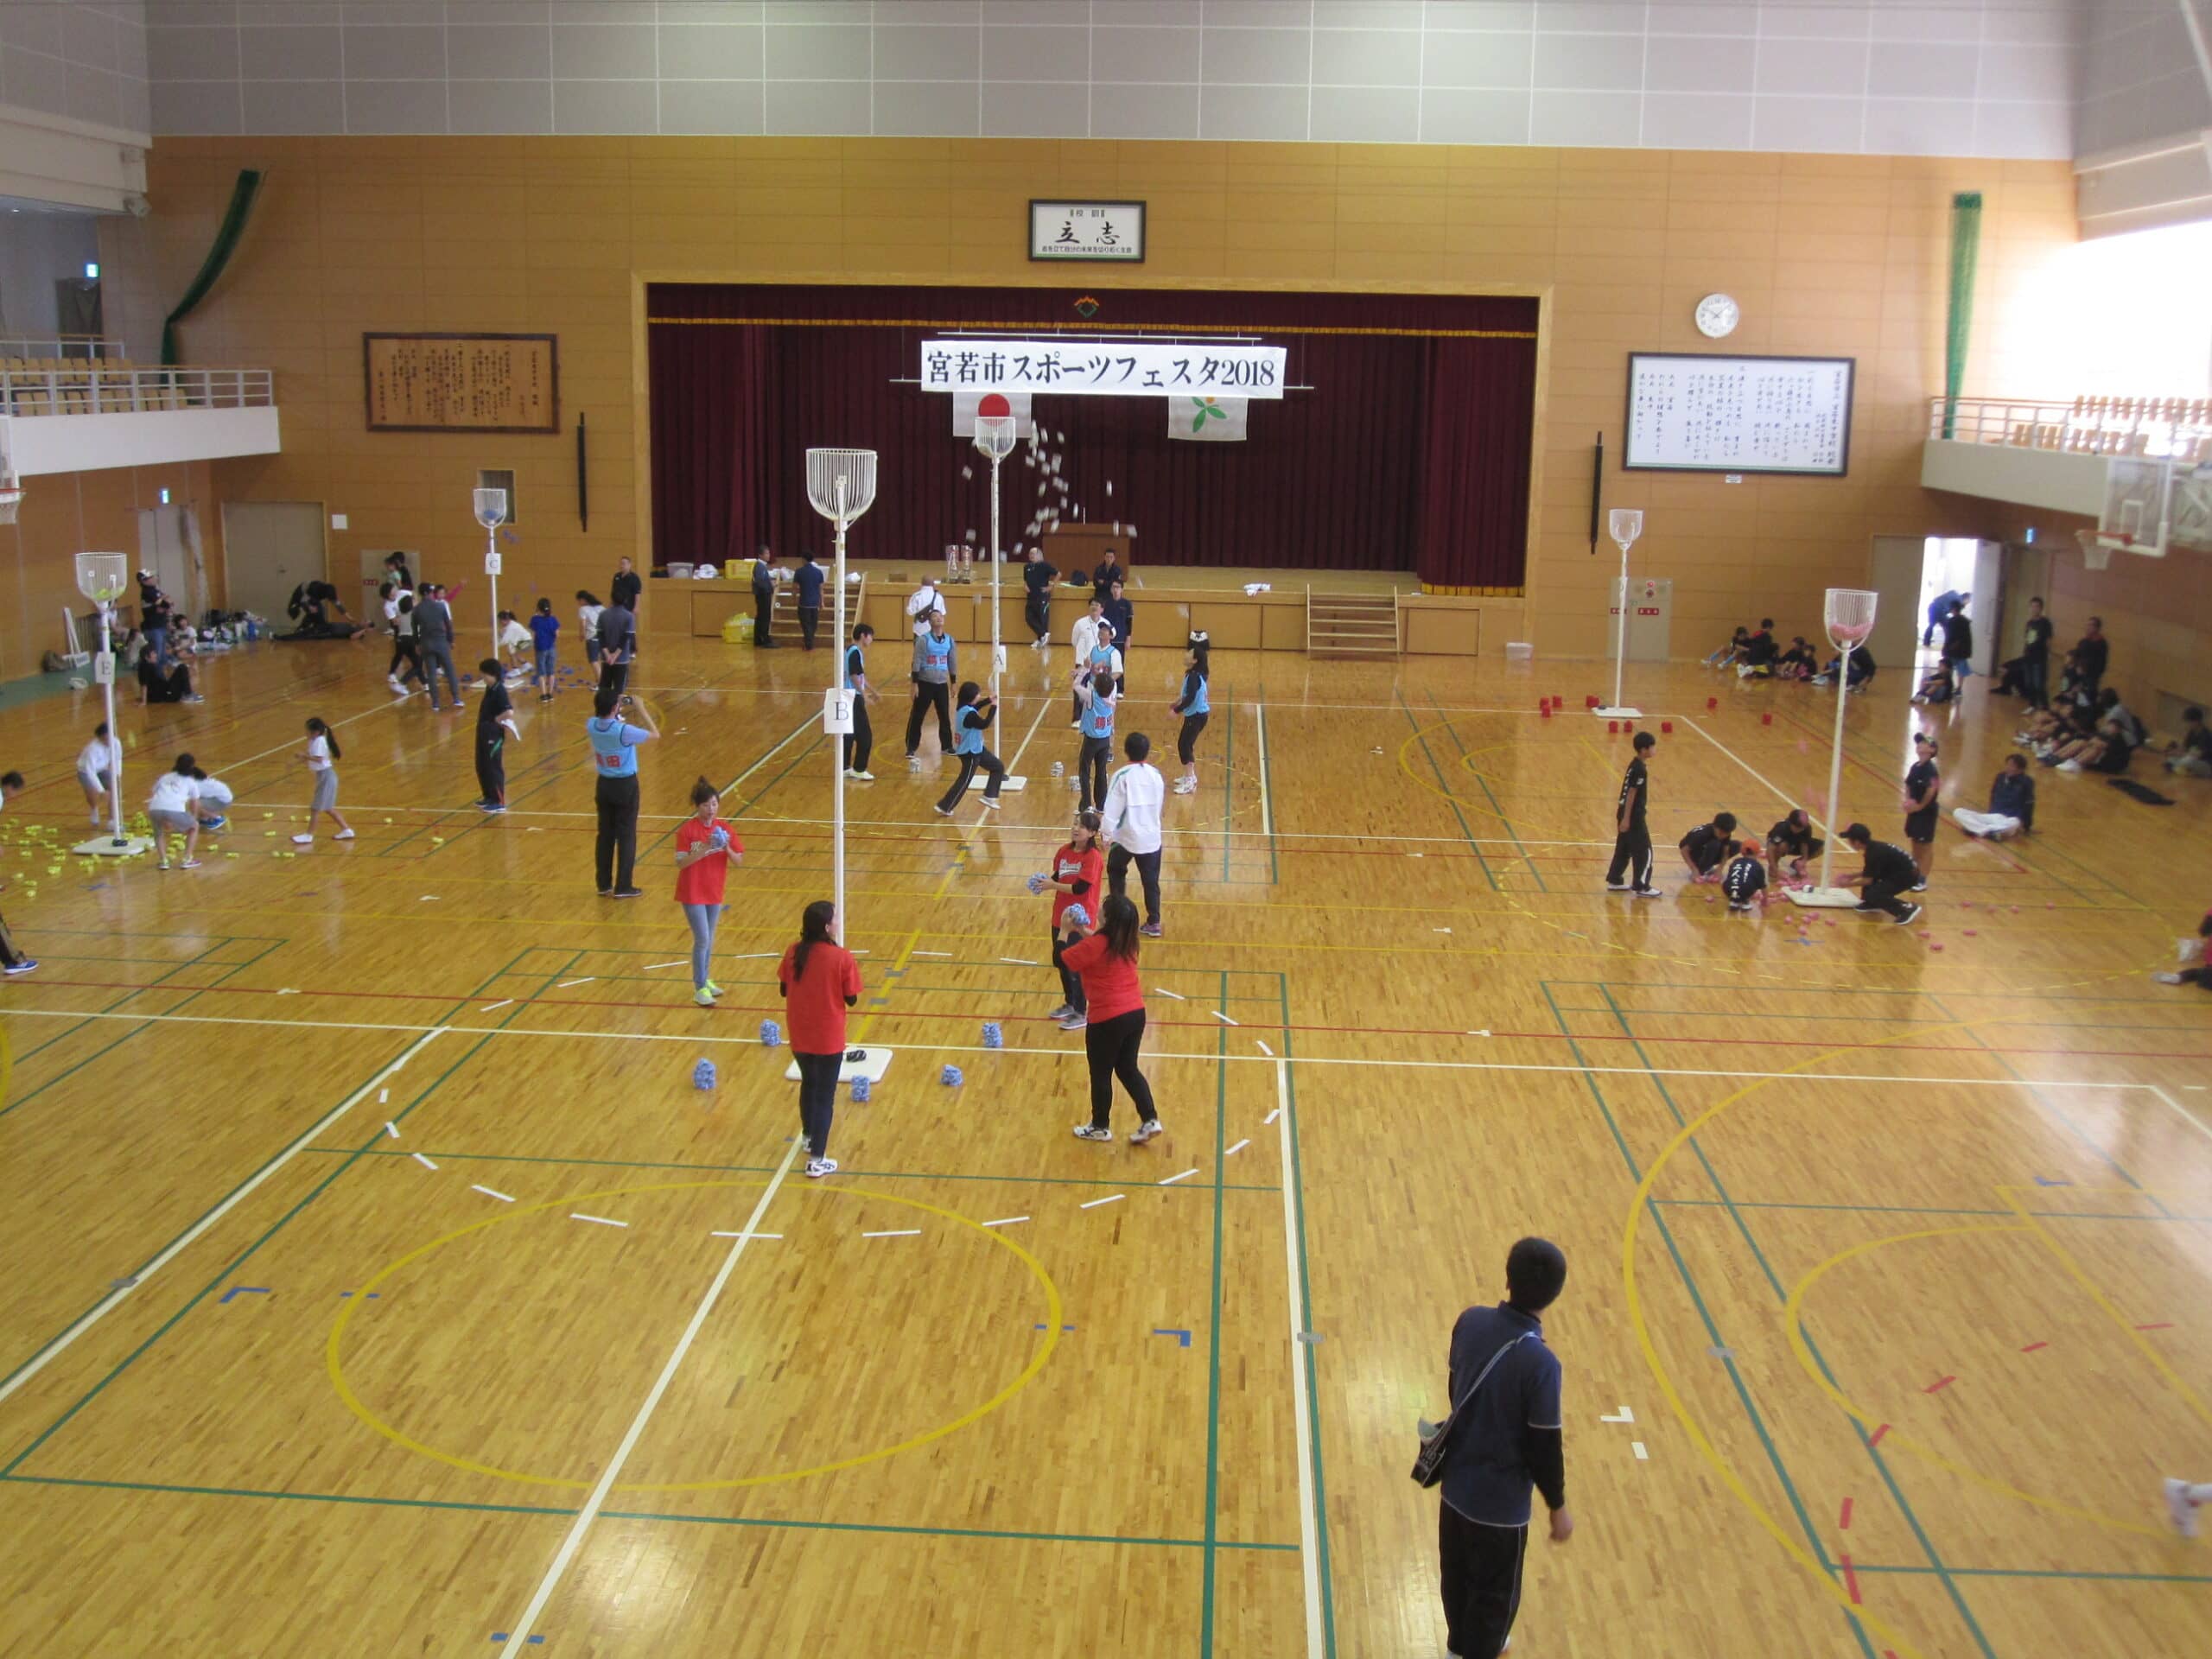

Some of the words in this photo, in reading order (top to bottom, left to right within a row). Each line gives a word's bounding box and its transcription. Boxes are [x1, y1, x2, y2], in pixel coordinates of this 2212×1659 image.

[927, 351, 1274, 387] 宮若市スポーツフェスタ2018
[993, 654, 1003, 665] A
[834, 702, 849, 721] B
